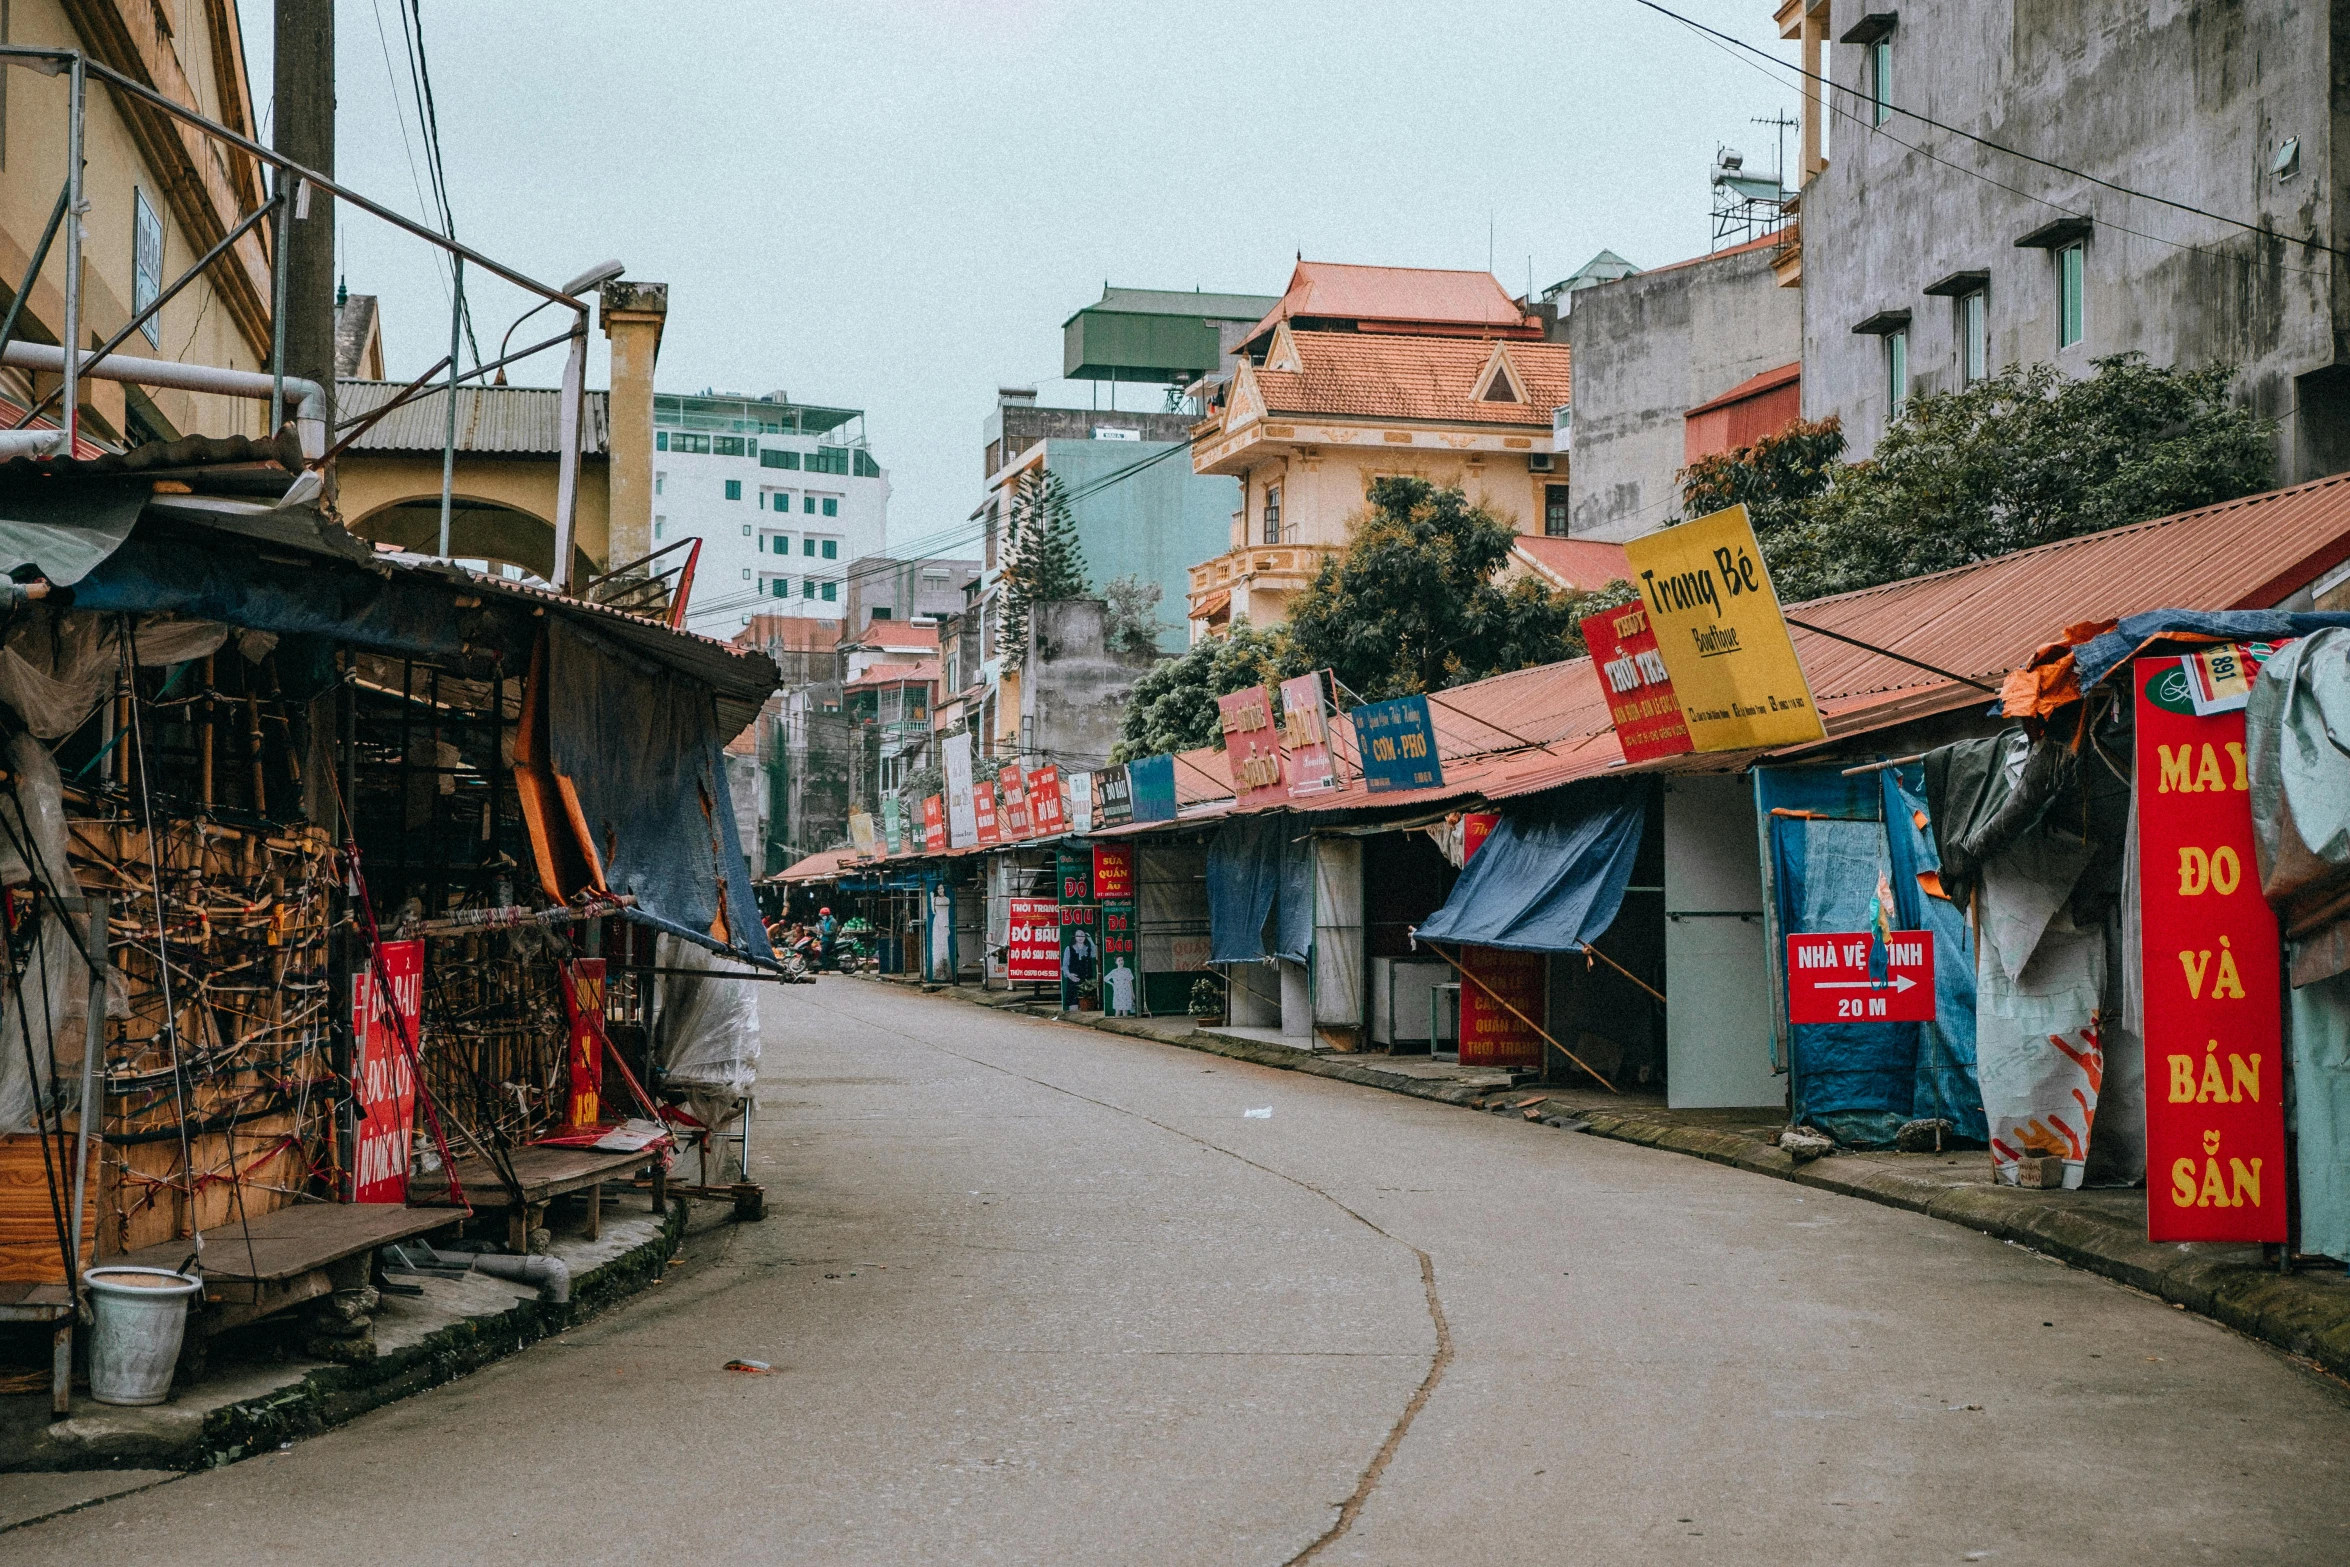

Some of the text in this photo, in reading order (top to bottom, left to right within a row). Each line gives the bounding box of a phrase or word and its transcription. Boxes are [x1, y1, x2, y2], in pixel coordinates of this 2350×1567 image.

[1641, 546, 1759, 618] Trang Bé
[1691, 624, 1740, 655] Boutique
[2211, 656, 2237, 683] 891
[1373, 735, 1397, 762] CƠM
[2157, 742, 2248, 794] MAY
[2178, 846, 2241, 896] ĐO
[1011, 902, 1059, 913] THỜI TRANG
[1011, 920, 1031, 942] ĐỒ
[1798, 941, 1923, 970] NHÀ VỆ INH
[2179, 935, 2246, 1000] VÀ
[1838, 998, 1887, 1017] 20 M
[1467, 1037, 1495, 1055] THỜI
[2168, 1039, 2261, 1104] BÁN
[2172, 1128, 2263, 1209] SẴN
